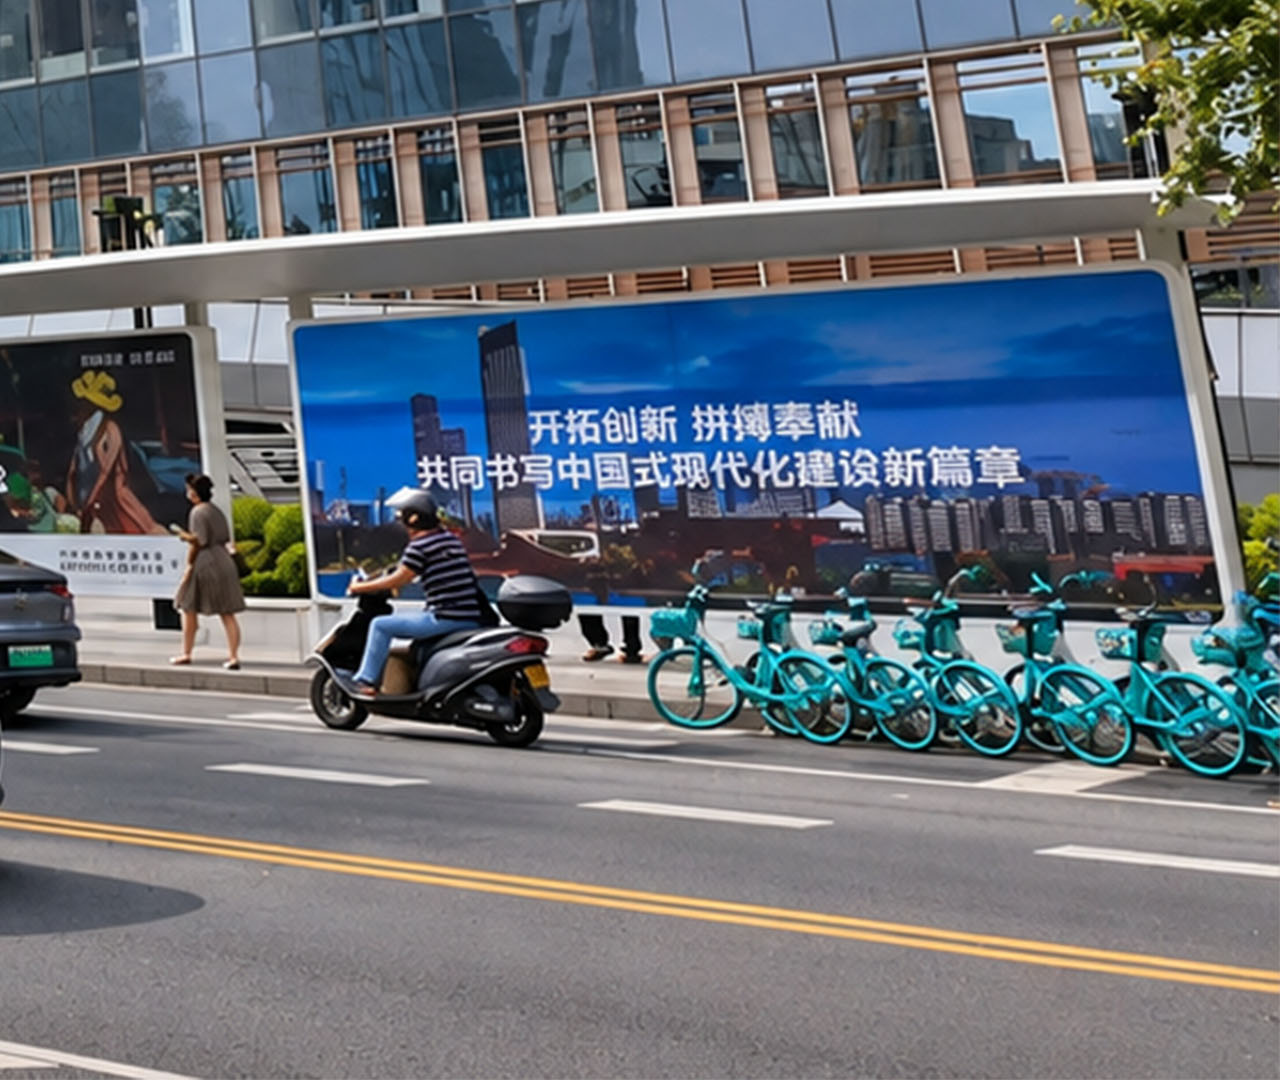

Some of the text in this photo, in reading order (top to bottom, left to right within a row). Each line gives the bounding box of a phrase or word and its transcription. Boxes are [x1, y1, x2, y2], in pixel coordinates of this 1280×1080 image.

[528, 405, 678, 446] 开拓创新
[416, 445, 1025, 491] 共同书写中国式现代化建设新篇章
